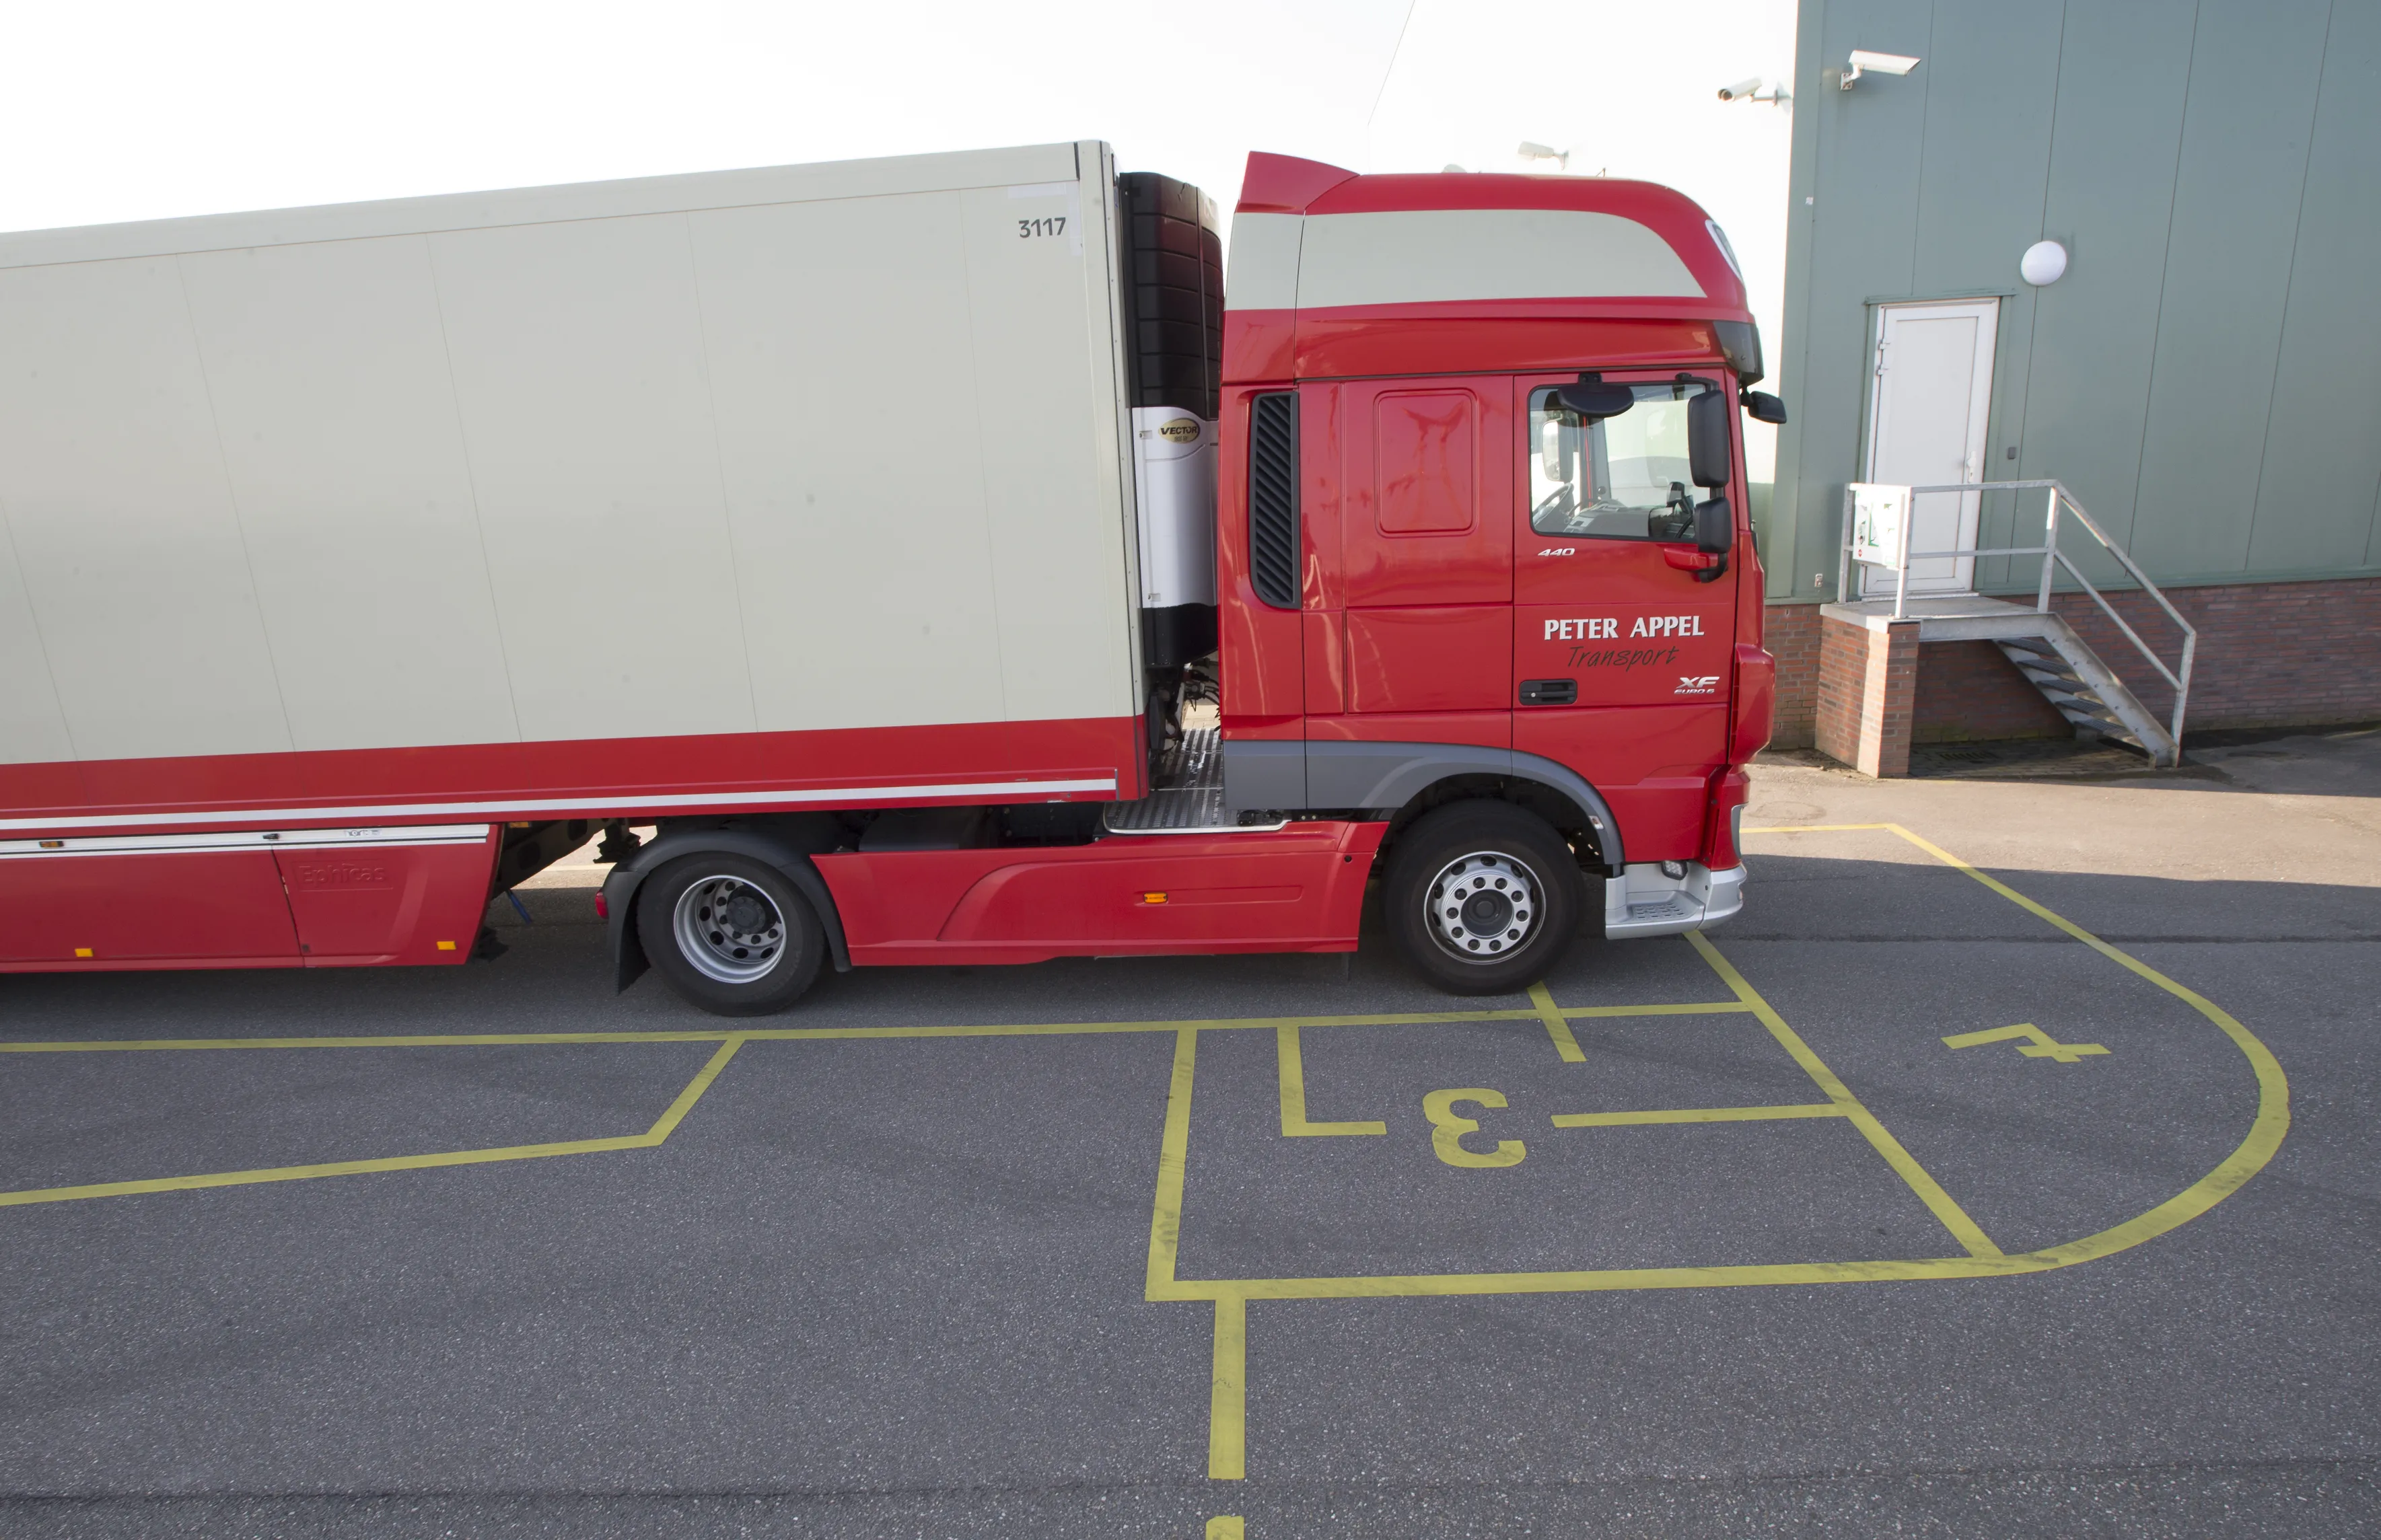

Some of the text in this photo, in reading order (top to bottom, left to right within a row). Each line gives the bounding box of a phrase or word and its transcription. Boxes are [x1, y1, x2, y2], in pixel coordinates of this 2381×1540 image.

[1018, 217, 1066, 238] 3117
[1160, 426, 1197, 435] VECTOR
[1537, 548, 1575, 556] 440
[1544, 616, 1705, 640] PETER APPEL
[1567, 645, 1679, 672] Transport
[1676, 676, 1720, 688] XF
[298, 863, 386, 888] Ephicas
[1422, 1087, 1527, 1169] 3
